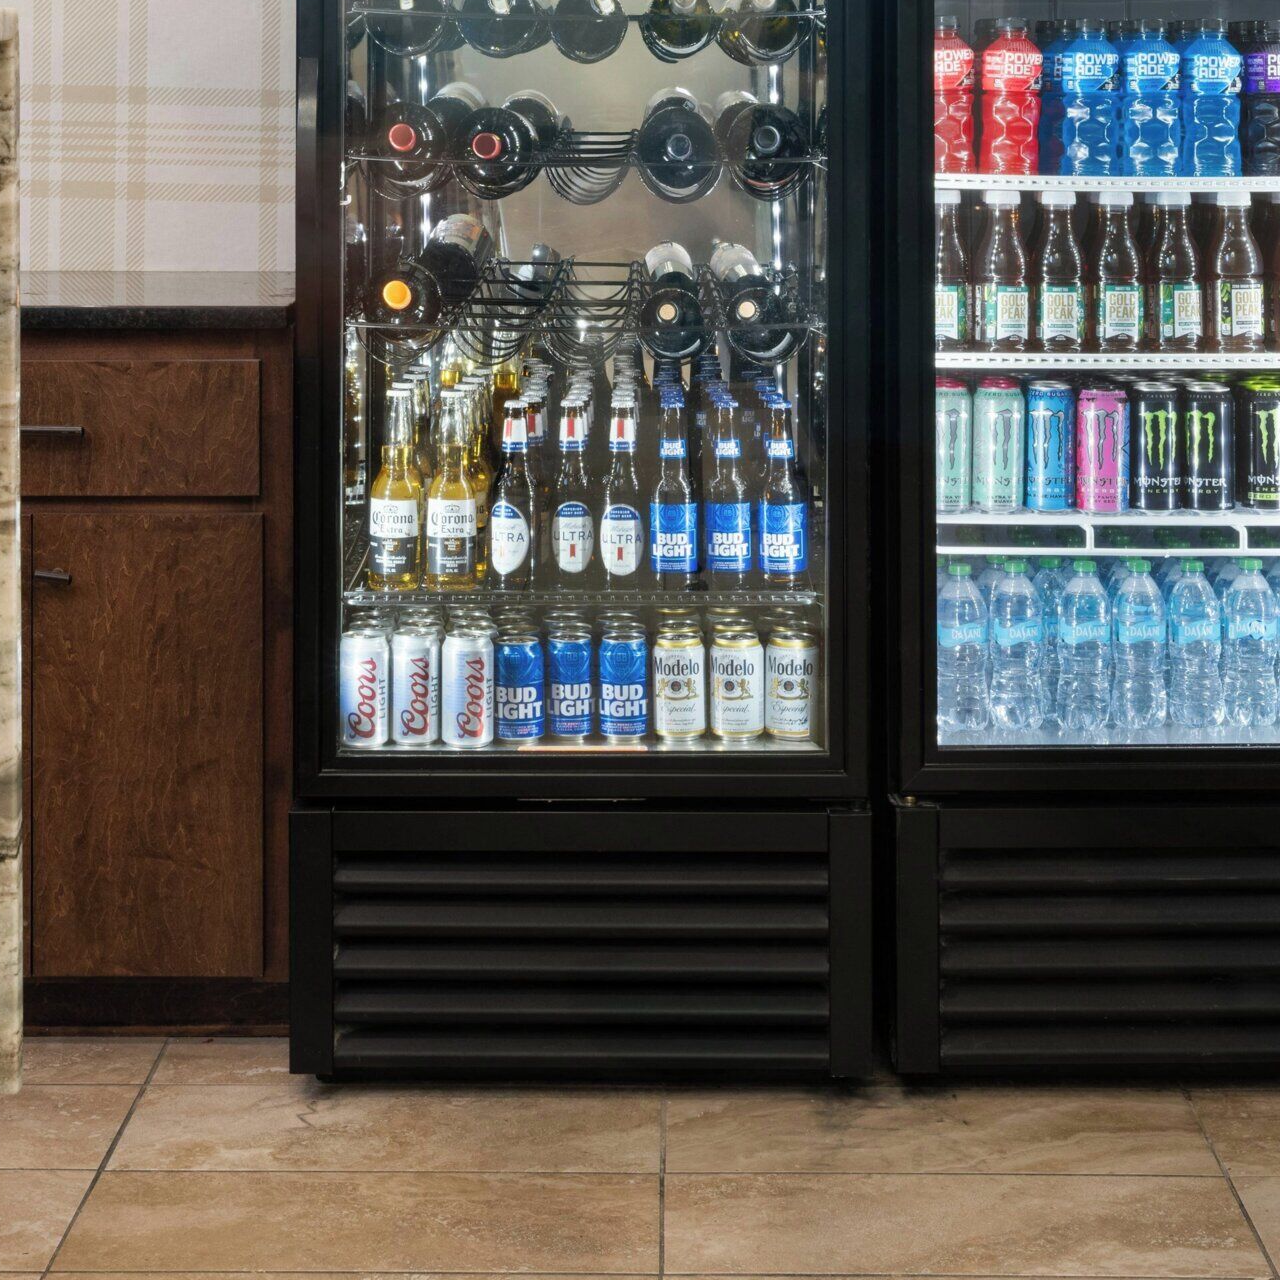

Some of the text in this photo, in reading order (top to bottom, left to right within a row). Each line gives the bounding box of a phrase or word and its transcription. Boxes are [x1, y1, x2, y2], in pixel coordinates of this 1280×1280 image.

[1001, 294, 1026, 307] GOLD
[1047, 294, 1074, 307] GOLD
[1109, 293, 1136, 306] GOLD
[1001, 307, 1026, 320] PEAK
[1047, 307, 1074, 320] PEAK
[1110, 306, 1136, 319] PEAK
[372, 510, 414, 525] Corona
[431, 510, 474, 526] Corona
[441, 526, 464, 534] Extra
[553, 530, 593, 541] ULTRA
[602, 533, 642, 544] ULTRA
[657, 532, 688, 545] BUD
[712, 532, 744, 545] BUD
[762, 533, 794, 545] BUD
[652, 543, 693, 557] LIGHT
[708, 543, 748, 557] LIGHT
[760, 544, 800, 557] LIGHT
[653, 655, 700, 677] Modelo
[709, 654, 755, 677] Modelo
[768, 654, 814, 677] Modelo
[348, 657, 377, 739] Coors
[401, 656, 430, 736] Coors
[457, 657, 485, 739] Coors
[495, 686, 537, 703] BUD
[551, 683, 593, 700] BUD
[601, 684, 644, 701] BUD
[494, 701, 543, 720] IGHT
[547, 698, 596, 717] LIGHT
[599, 698, 648, 718] LIGHT
